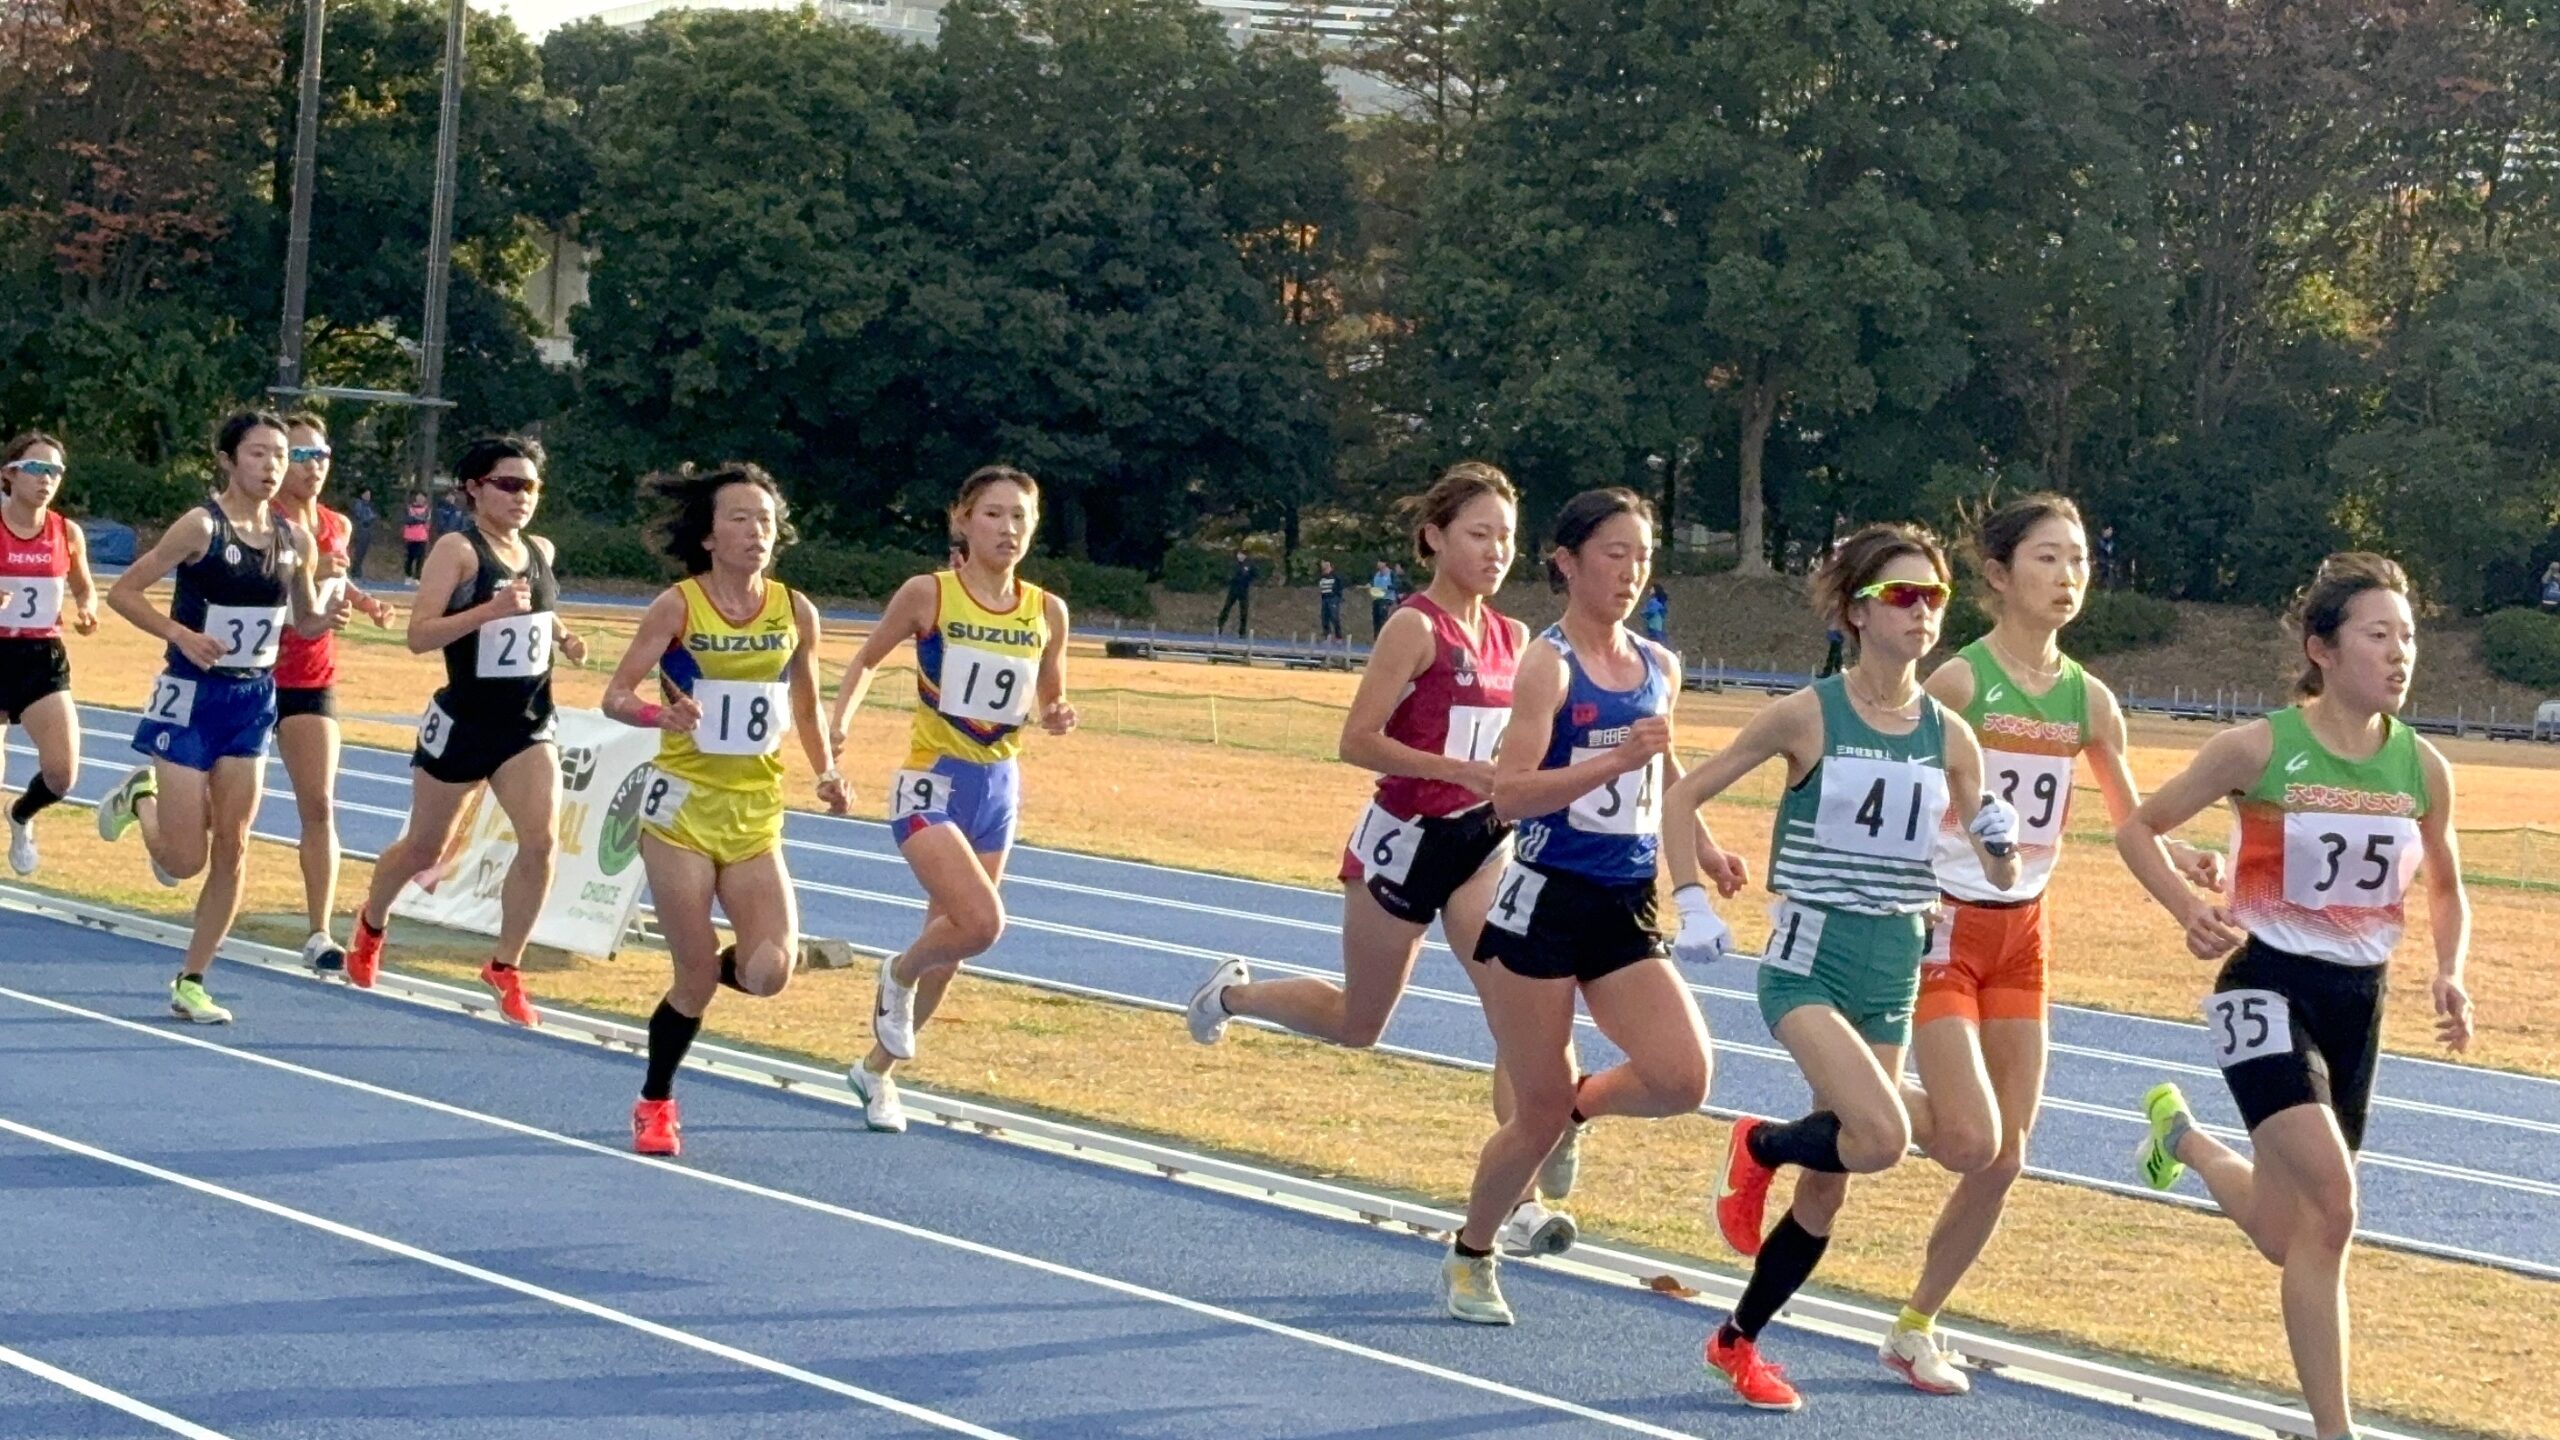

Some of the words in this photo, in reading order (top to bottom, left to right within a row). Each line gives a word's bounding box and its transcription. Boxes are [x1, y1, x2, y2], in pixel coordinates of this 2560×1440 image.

[8, 552, 52, 564] DENSO
[20, 586, 38, 618] 3
[228, 618, 273, 656] 32
[497, 625, 541, 667] 28
[689, 632, 795, 652] SUZUKI
[946, 621, 1041, 649] SUZUKI
[962, 661, 1017, 711] 19
[424, 704, 441, 744] 8
[719, 694, 770, 742] 18
[1588, 727, 1631, 747] 豊田自
[895, 774, 934, 811] 19
[1597, 762, 1653, 817] 34
[1855, 777, 1922, 841] 41
[2000, 769, 2058, 828] 39
[1357, 808, 1401, 867] 16
[2314, 831, 2394, 893] 35
[1765, 911, 1802, 961] 1
[2215, 997, 2269, 1055] 35
